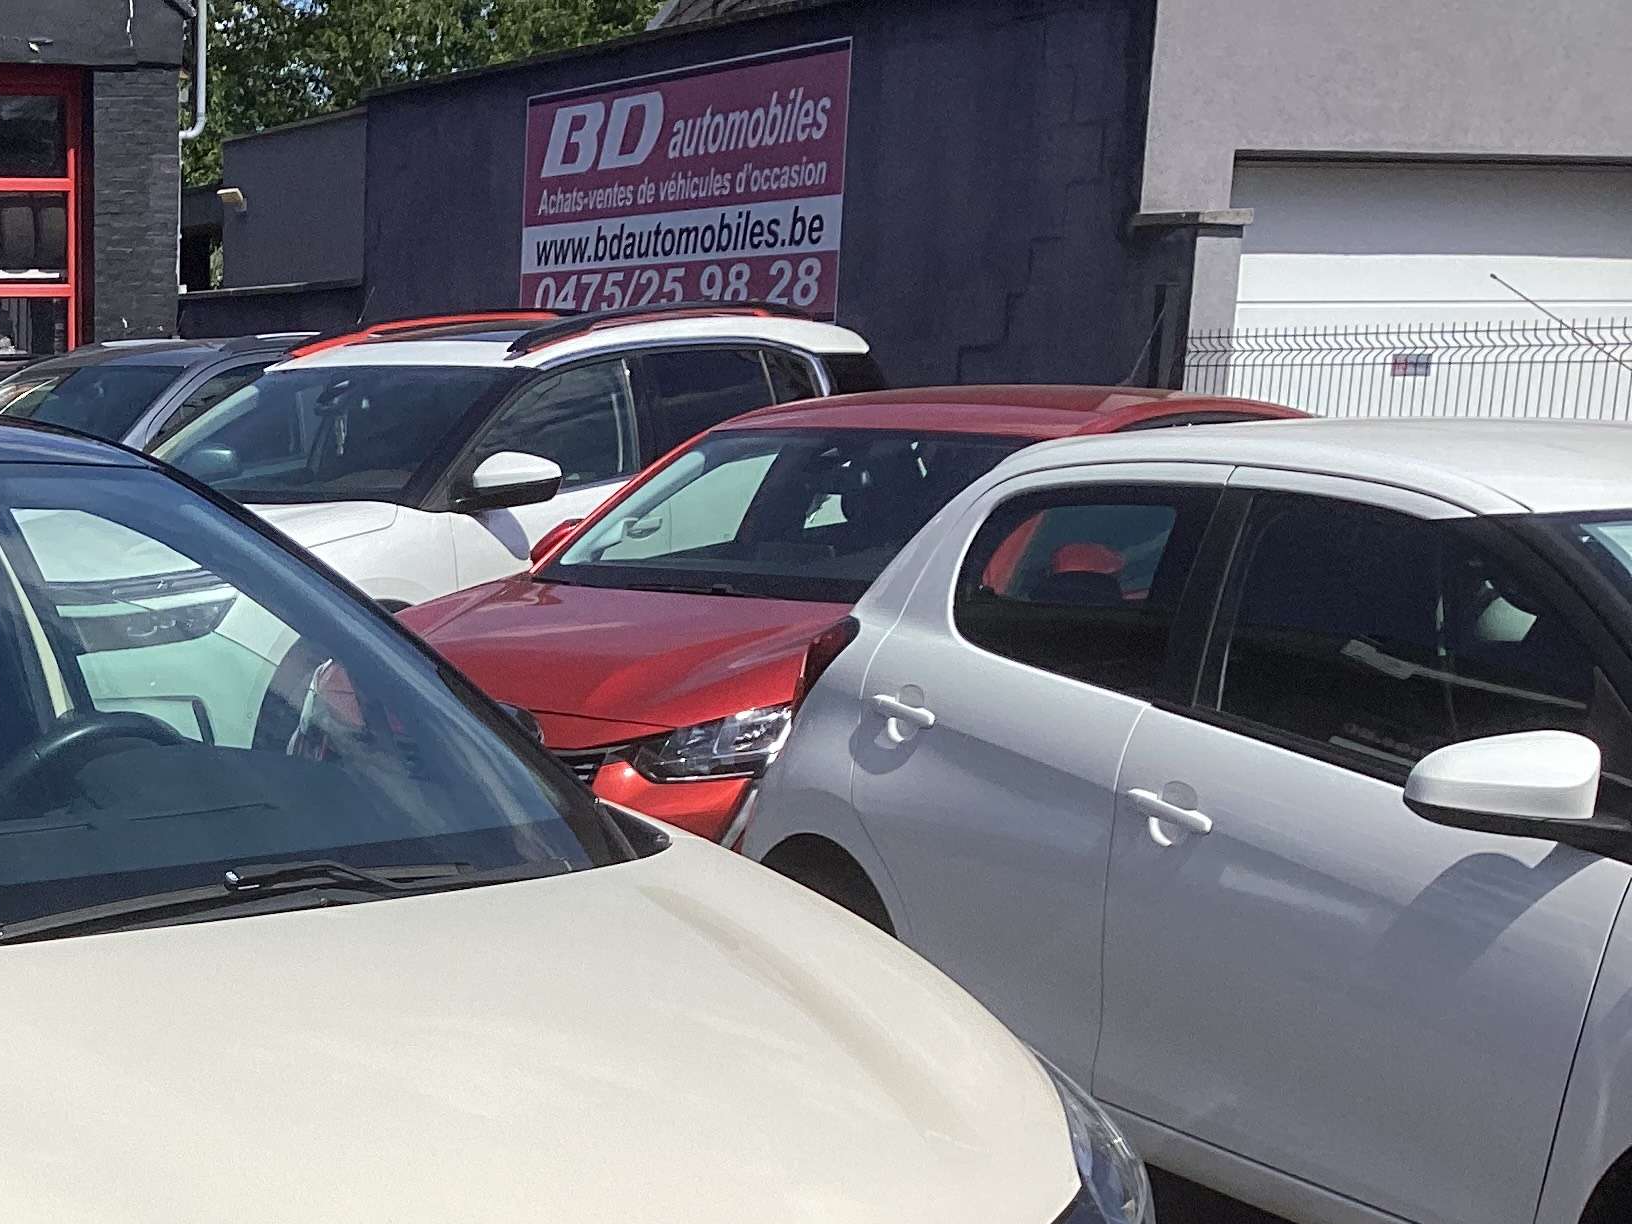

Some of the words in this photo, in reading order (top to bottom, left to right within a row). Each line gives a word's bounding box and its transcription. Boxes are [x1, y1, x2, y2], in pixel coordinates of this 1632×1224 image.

[541, 91, 664, 178] BD
[668, 87, 831, 160] automobiles
[537, 180, 633, 216] Achats-ventes
[636, 177, 656, 204] de
[659, 168, 732, 201] véhicules
[736, 156, 827, 193] d'occasion
[535, 206, 825, 267] www.bdautomobiles.be
[535, 266, 686, 312] 0475/25
[699, 262, 751, 302] 98
[768, 258, 822, 306] 28
